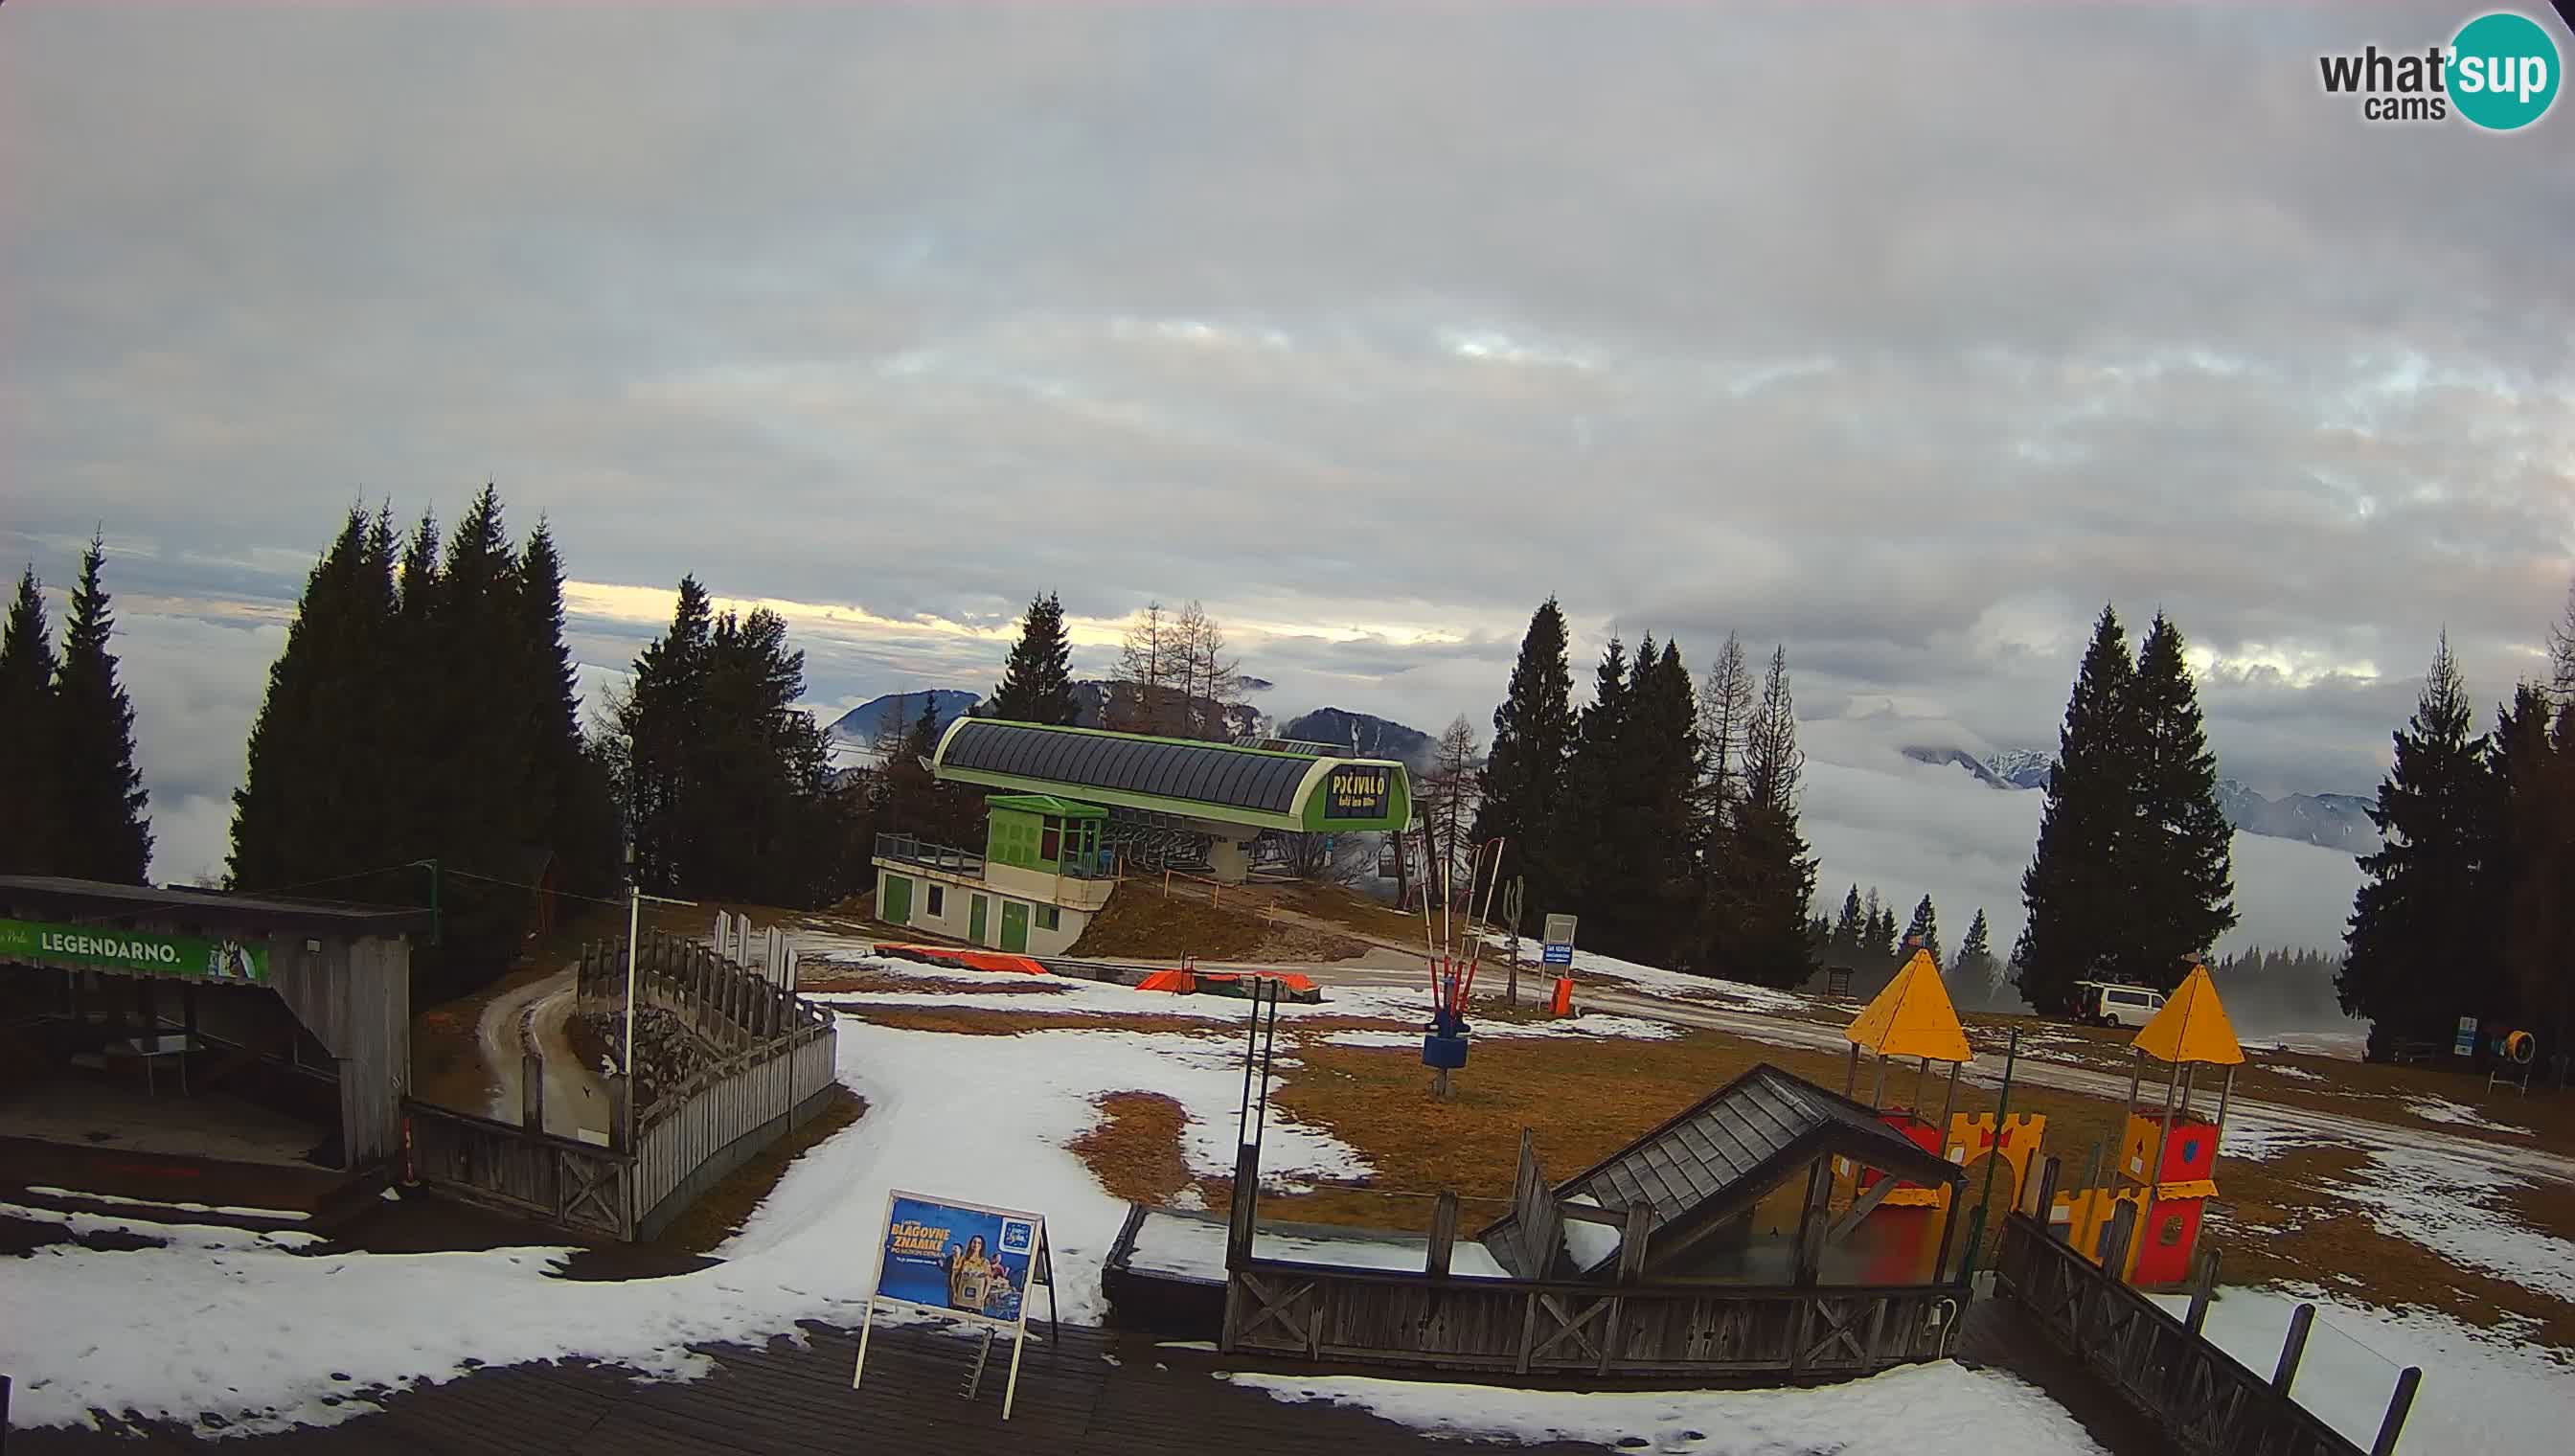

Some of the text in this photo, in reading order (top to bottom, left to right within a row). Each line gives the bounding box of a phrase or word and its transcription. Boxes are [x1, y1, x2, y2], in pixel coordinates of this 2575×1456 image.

[41, 931, 181, 964] LEGENDARNO.
[891, 1223, 951, 1240] BLAGOVNE
[894, 1236, 944, 1252] ZNAMKE
